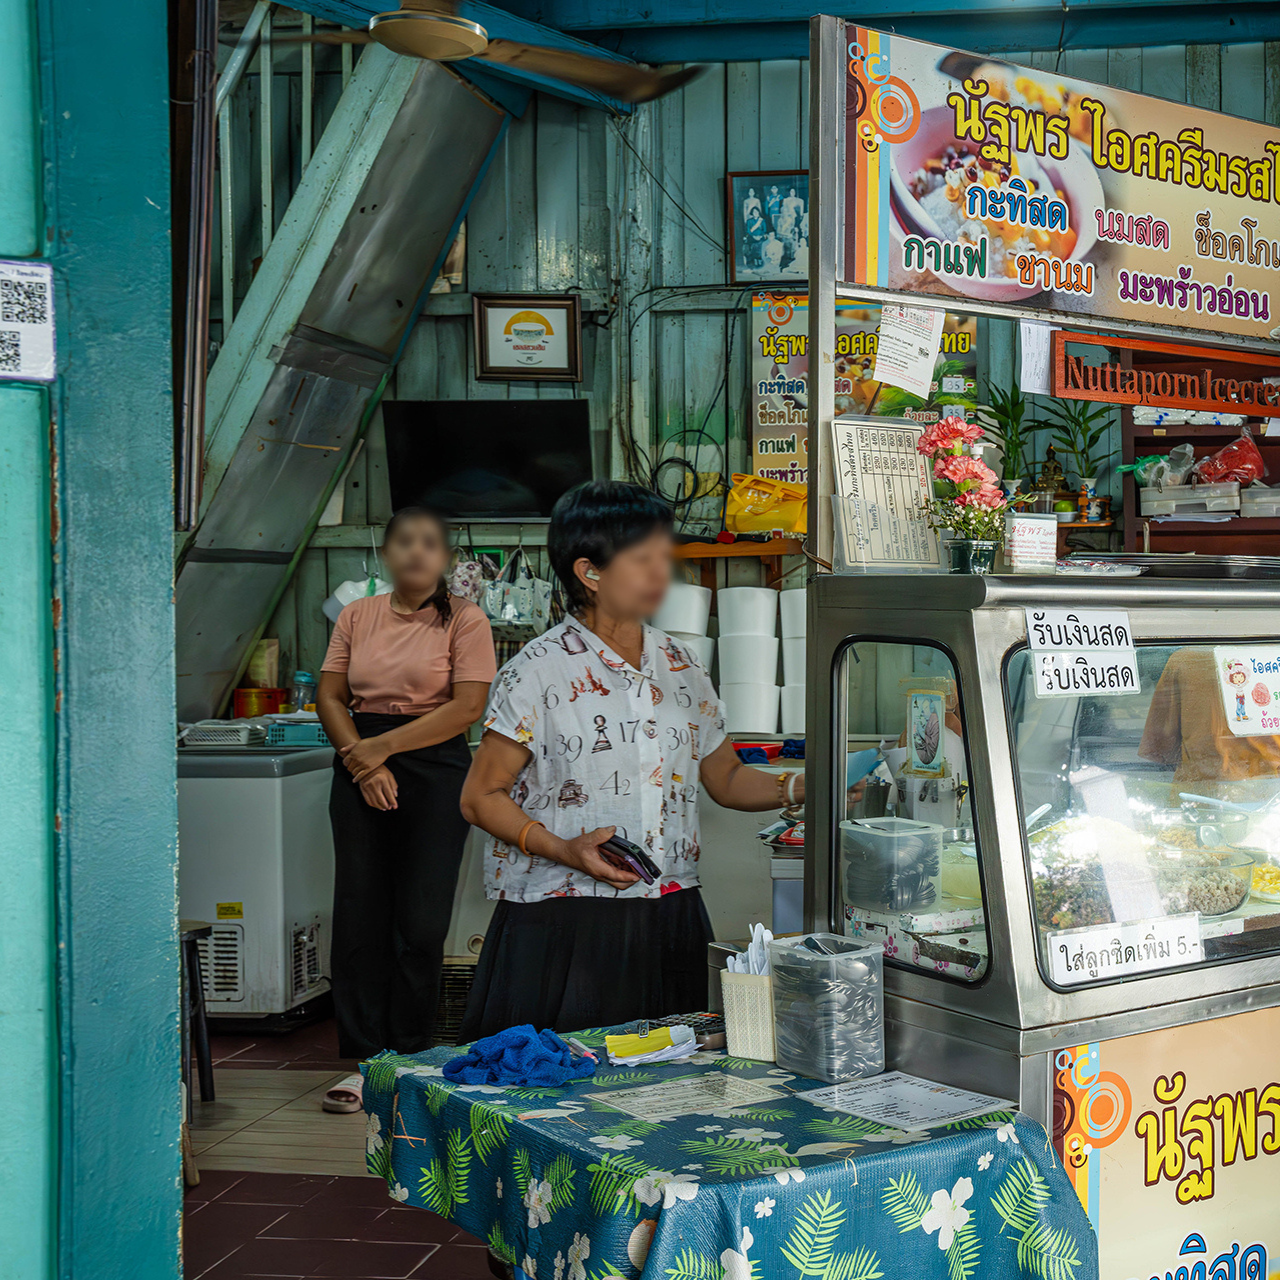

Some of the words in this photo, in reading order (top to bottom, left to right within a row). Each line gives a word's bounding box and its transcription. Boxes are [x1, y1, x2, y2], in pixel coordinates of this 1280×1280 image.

[948, 80, 1070, 164] นัฐพร
[966, 176, 1068, 232] กะทิสด
[1095, 206, 1170, 251] นมสด
[904, 235, 988, 278] กาแฟ
[1016, 252, 1093, 295] ชานม
[1119, 266, 1269, 321] มะพร้าวอ่อน
[758, 375, 805, 396] กะทิสด
[1064, 355, 1199, 403] Nuttaporn
[758, 435, 796, 454] กาแฟ
[1033, 611, 1130, 650] รับเงินสด
[1040, 655, 1136, 692] รับเงินสด
[1060, 932, 1172, 984] ใส่ลูกชิดเพิ่ม
[1176, 934, 1200, 960] 5.-
